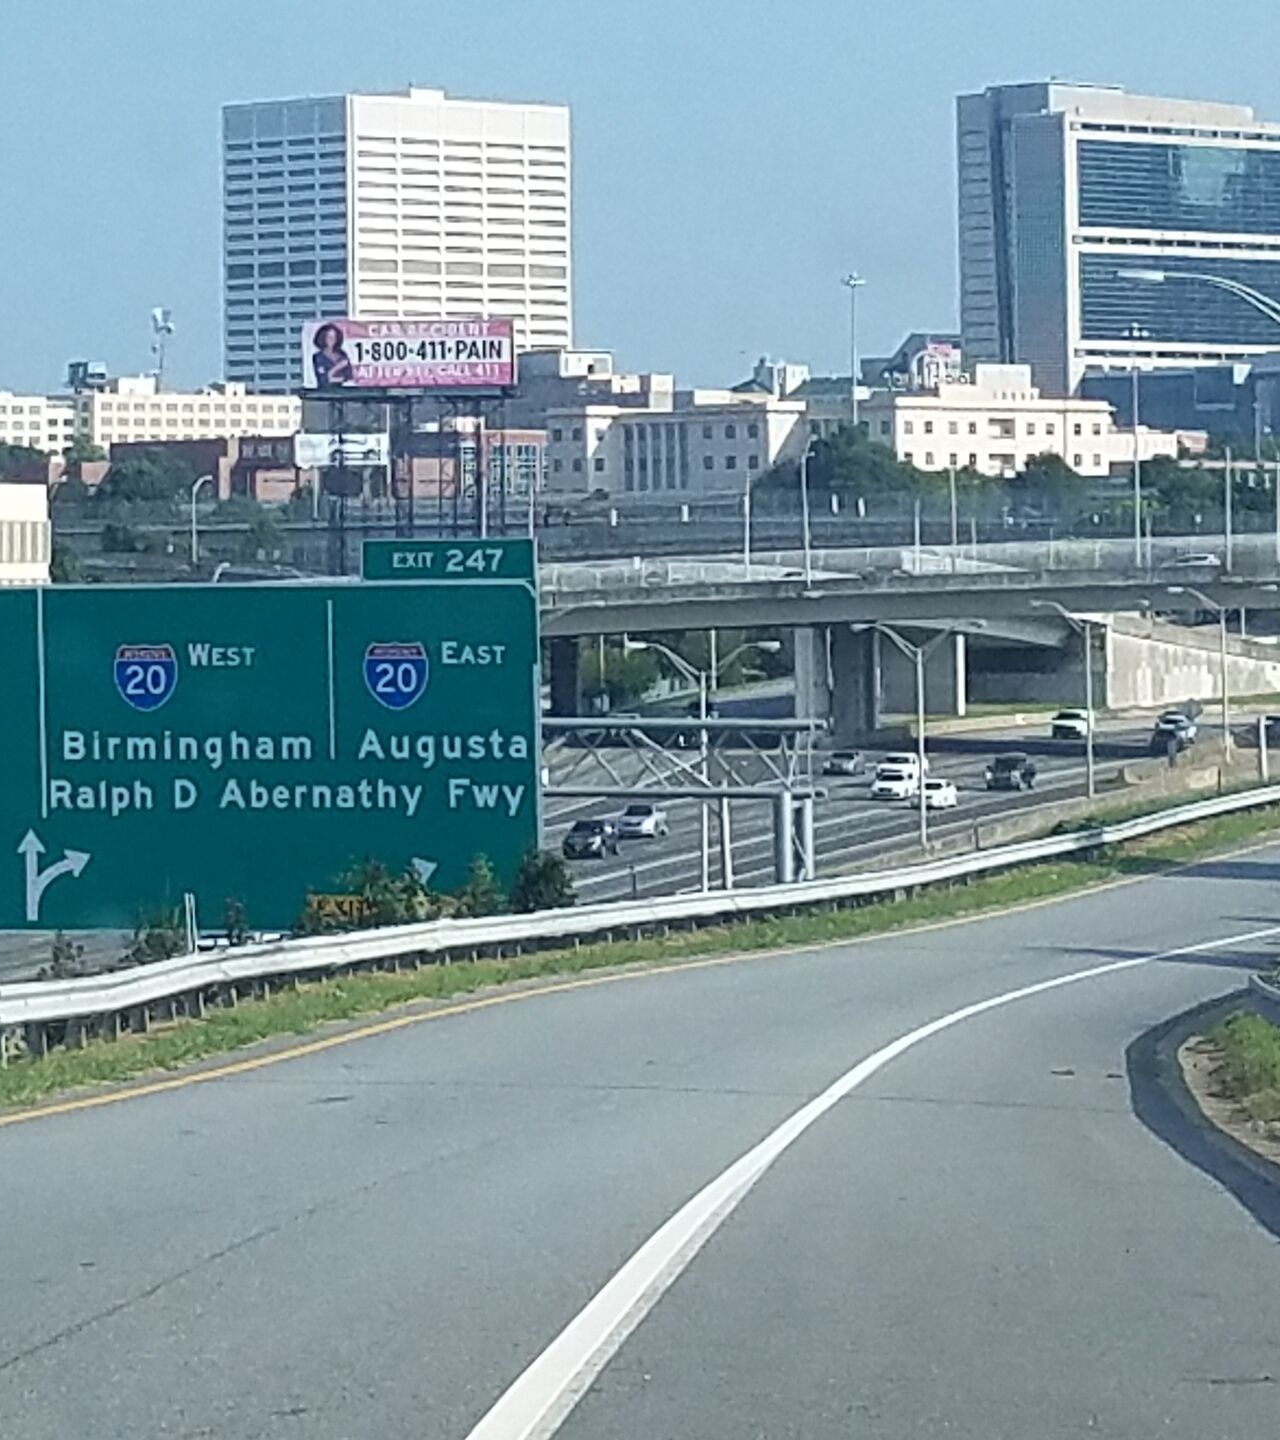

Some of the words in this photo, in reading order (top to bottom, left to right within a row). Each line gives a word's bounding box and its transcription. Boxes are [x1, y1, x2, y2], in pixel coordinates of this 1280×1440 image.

[474, 363, 500, 377] 411
[392, 551, 434, 569] EXIT
[445, 548, 504, 572] 247
[125, 665, 167, 695] 20
[187, 642, 256, 667] WEST
[375, 662, 418, 693] 20
[441, 641, 506, 665] EAST
[63, 730, 312, 768] Birmingham
[358, 729, 528, 768] Augusta
[50, 778, 153, 816] Ralph
[173, 779, 198, 808] D
[219, 778, 423, 816] Abernathy
[448, 778, 526, 816] Fwy
